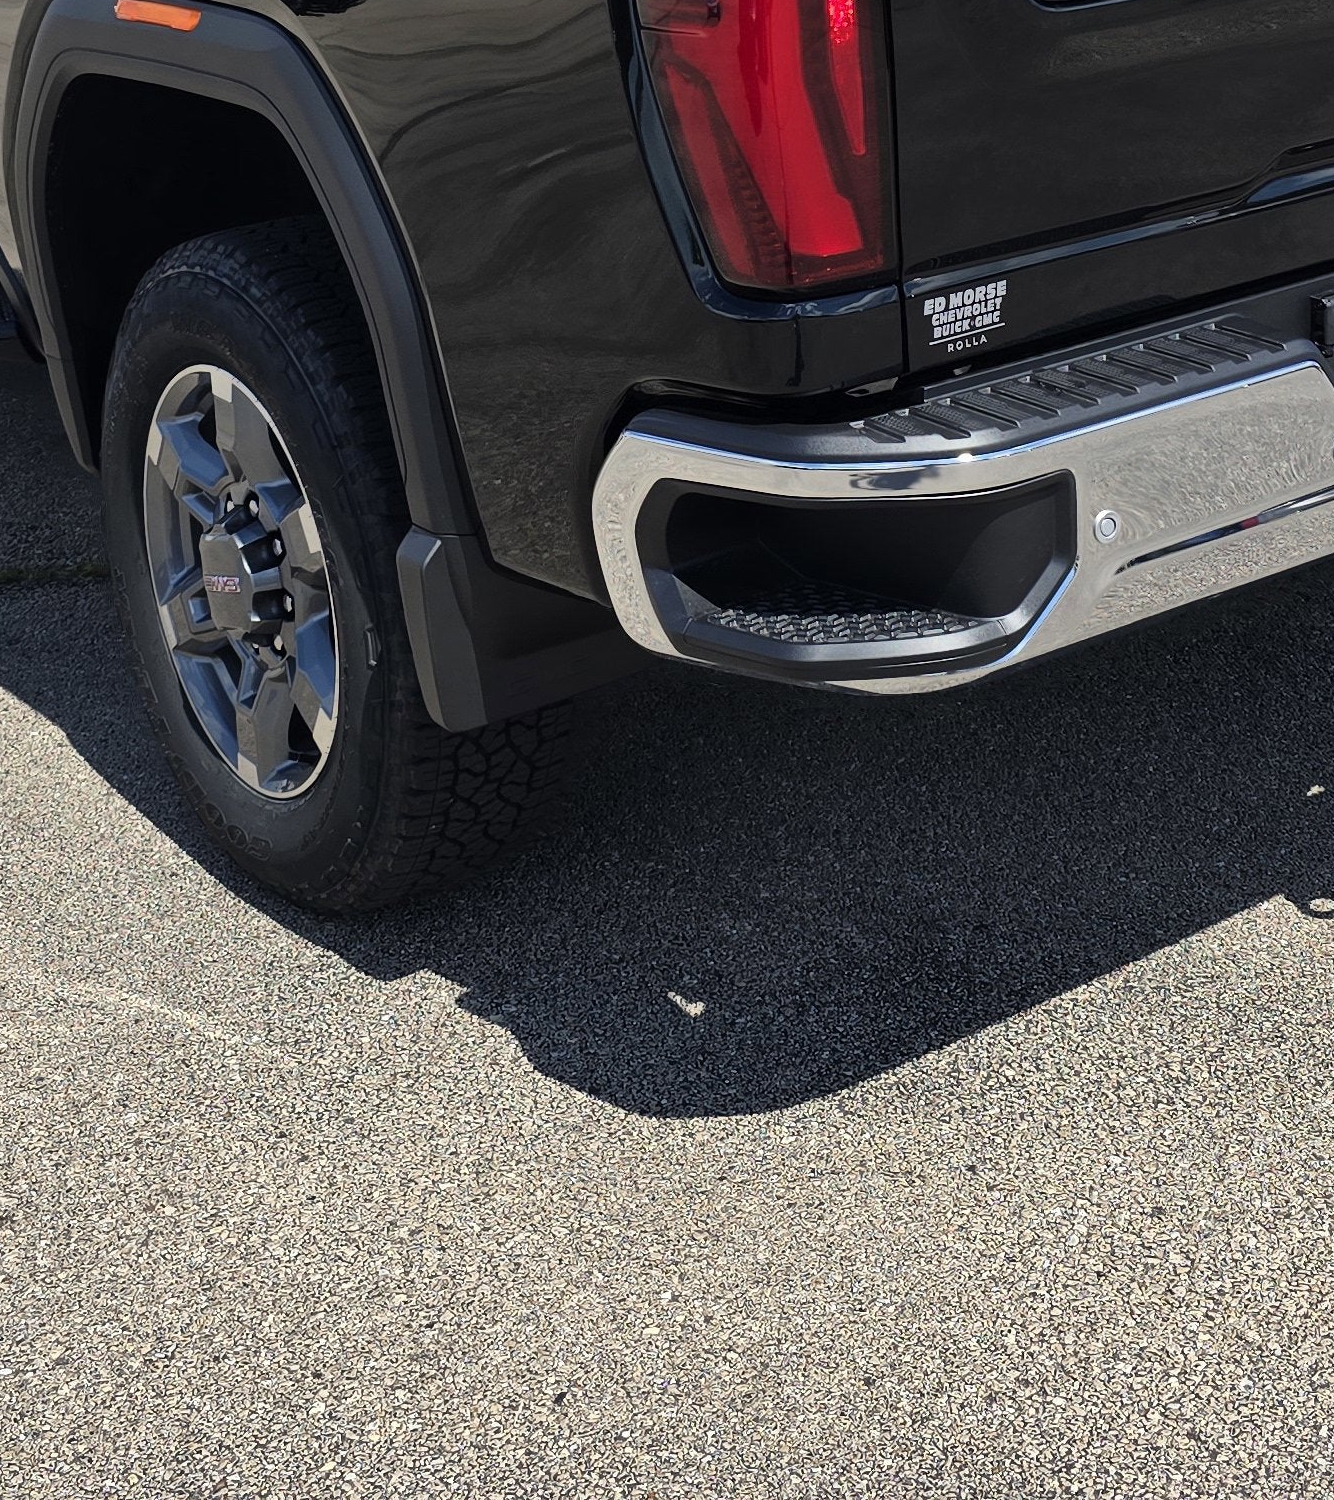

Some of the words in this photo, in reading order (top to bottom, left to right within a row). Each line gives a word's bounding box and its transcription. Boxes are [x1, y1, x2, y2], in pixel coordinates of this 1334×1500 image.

[923, 296, 946, 316] ED
[948, 279, 1007, 310] MORSE
[931, 296, 1003, 327] CHEVROLET
[947, 334, 988, 353] ROLLA
